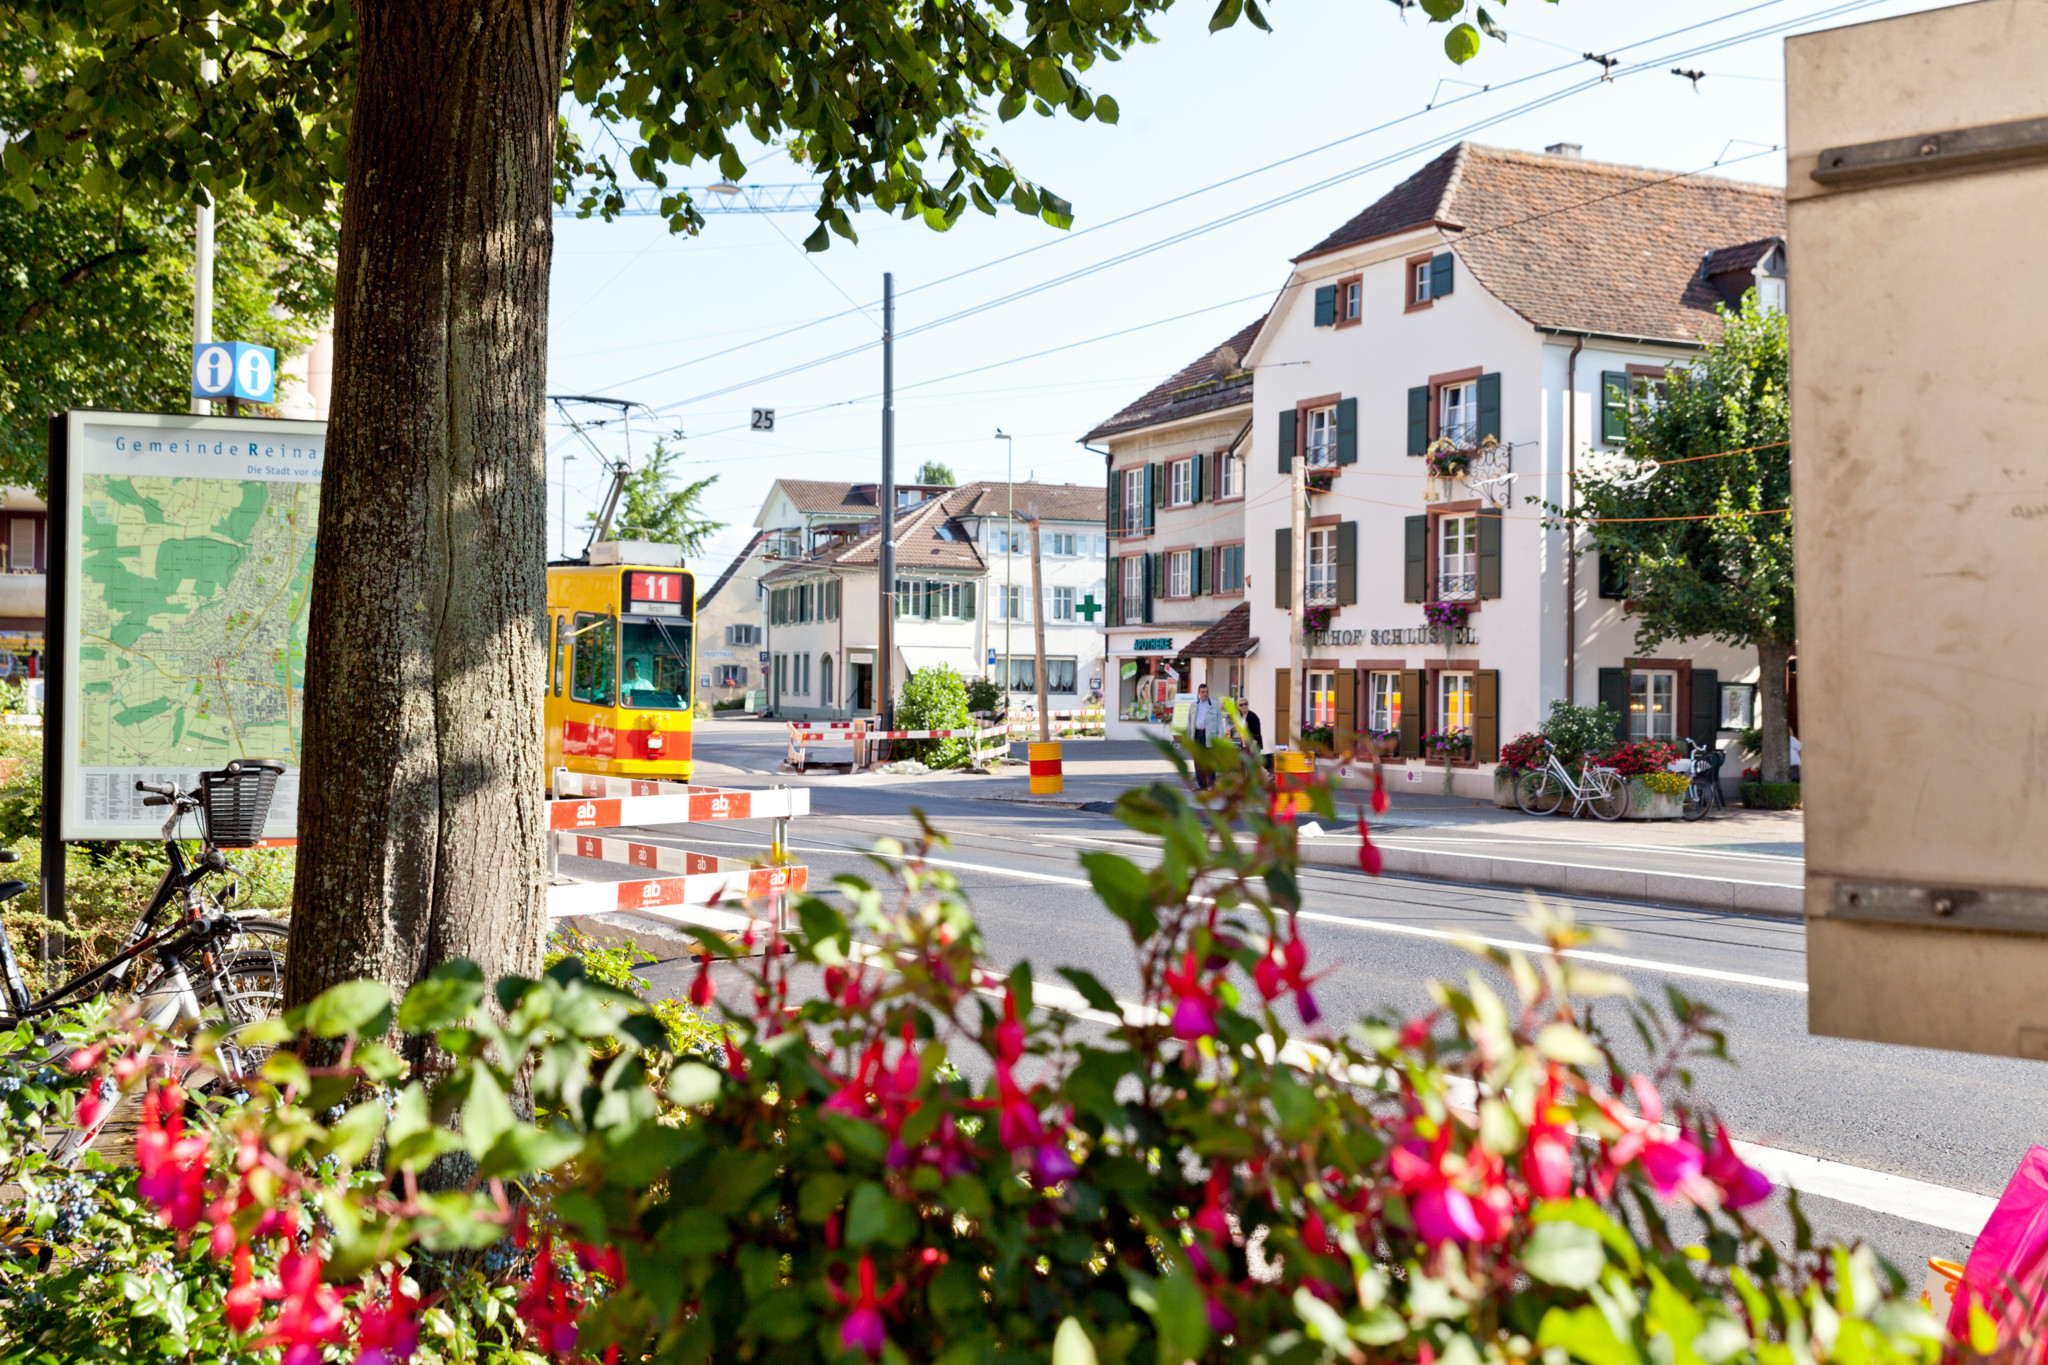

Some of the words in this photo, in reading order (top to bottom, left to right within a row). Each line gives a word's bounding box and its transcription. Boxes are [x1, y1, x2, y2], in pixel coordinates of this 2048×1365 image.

[752, 410, 774, 429] 25
[116, 437, 238, 456] Gemeinde
[247, 464, 262, 474] Die
[265, 465, 290, 476] Stadt
[294, 469, 308, 477] vor
[645, 575, 668, 600] 11
[1371, 625, 1475, 645] SCHLÜSEL
[1134, 638, 1171, 650] APOTHEKE
[576, 801, 596, 819] ab
[711, 794, 728, 811] ab
[585, 839, 594, 852] ab
[638, 847, 647, 861] ab
[697, 856, 706, 871] ab
[769, 870, 786, 885] ab
[642, 880, 661, 898] ab
